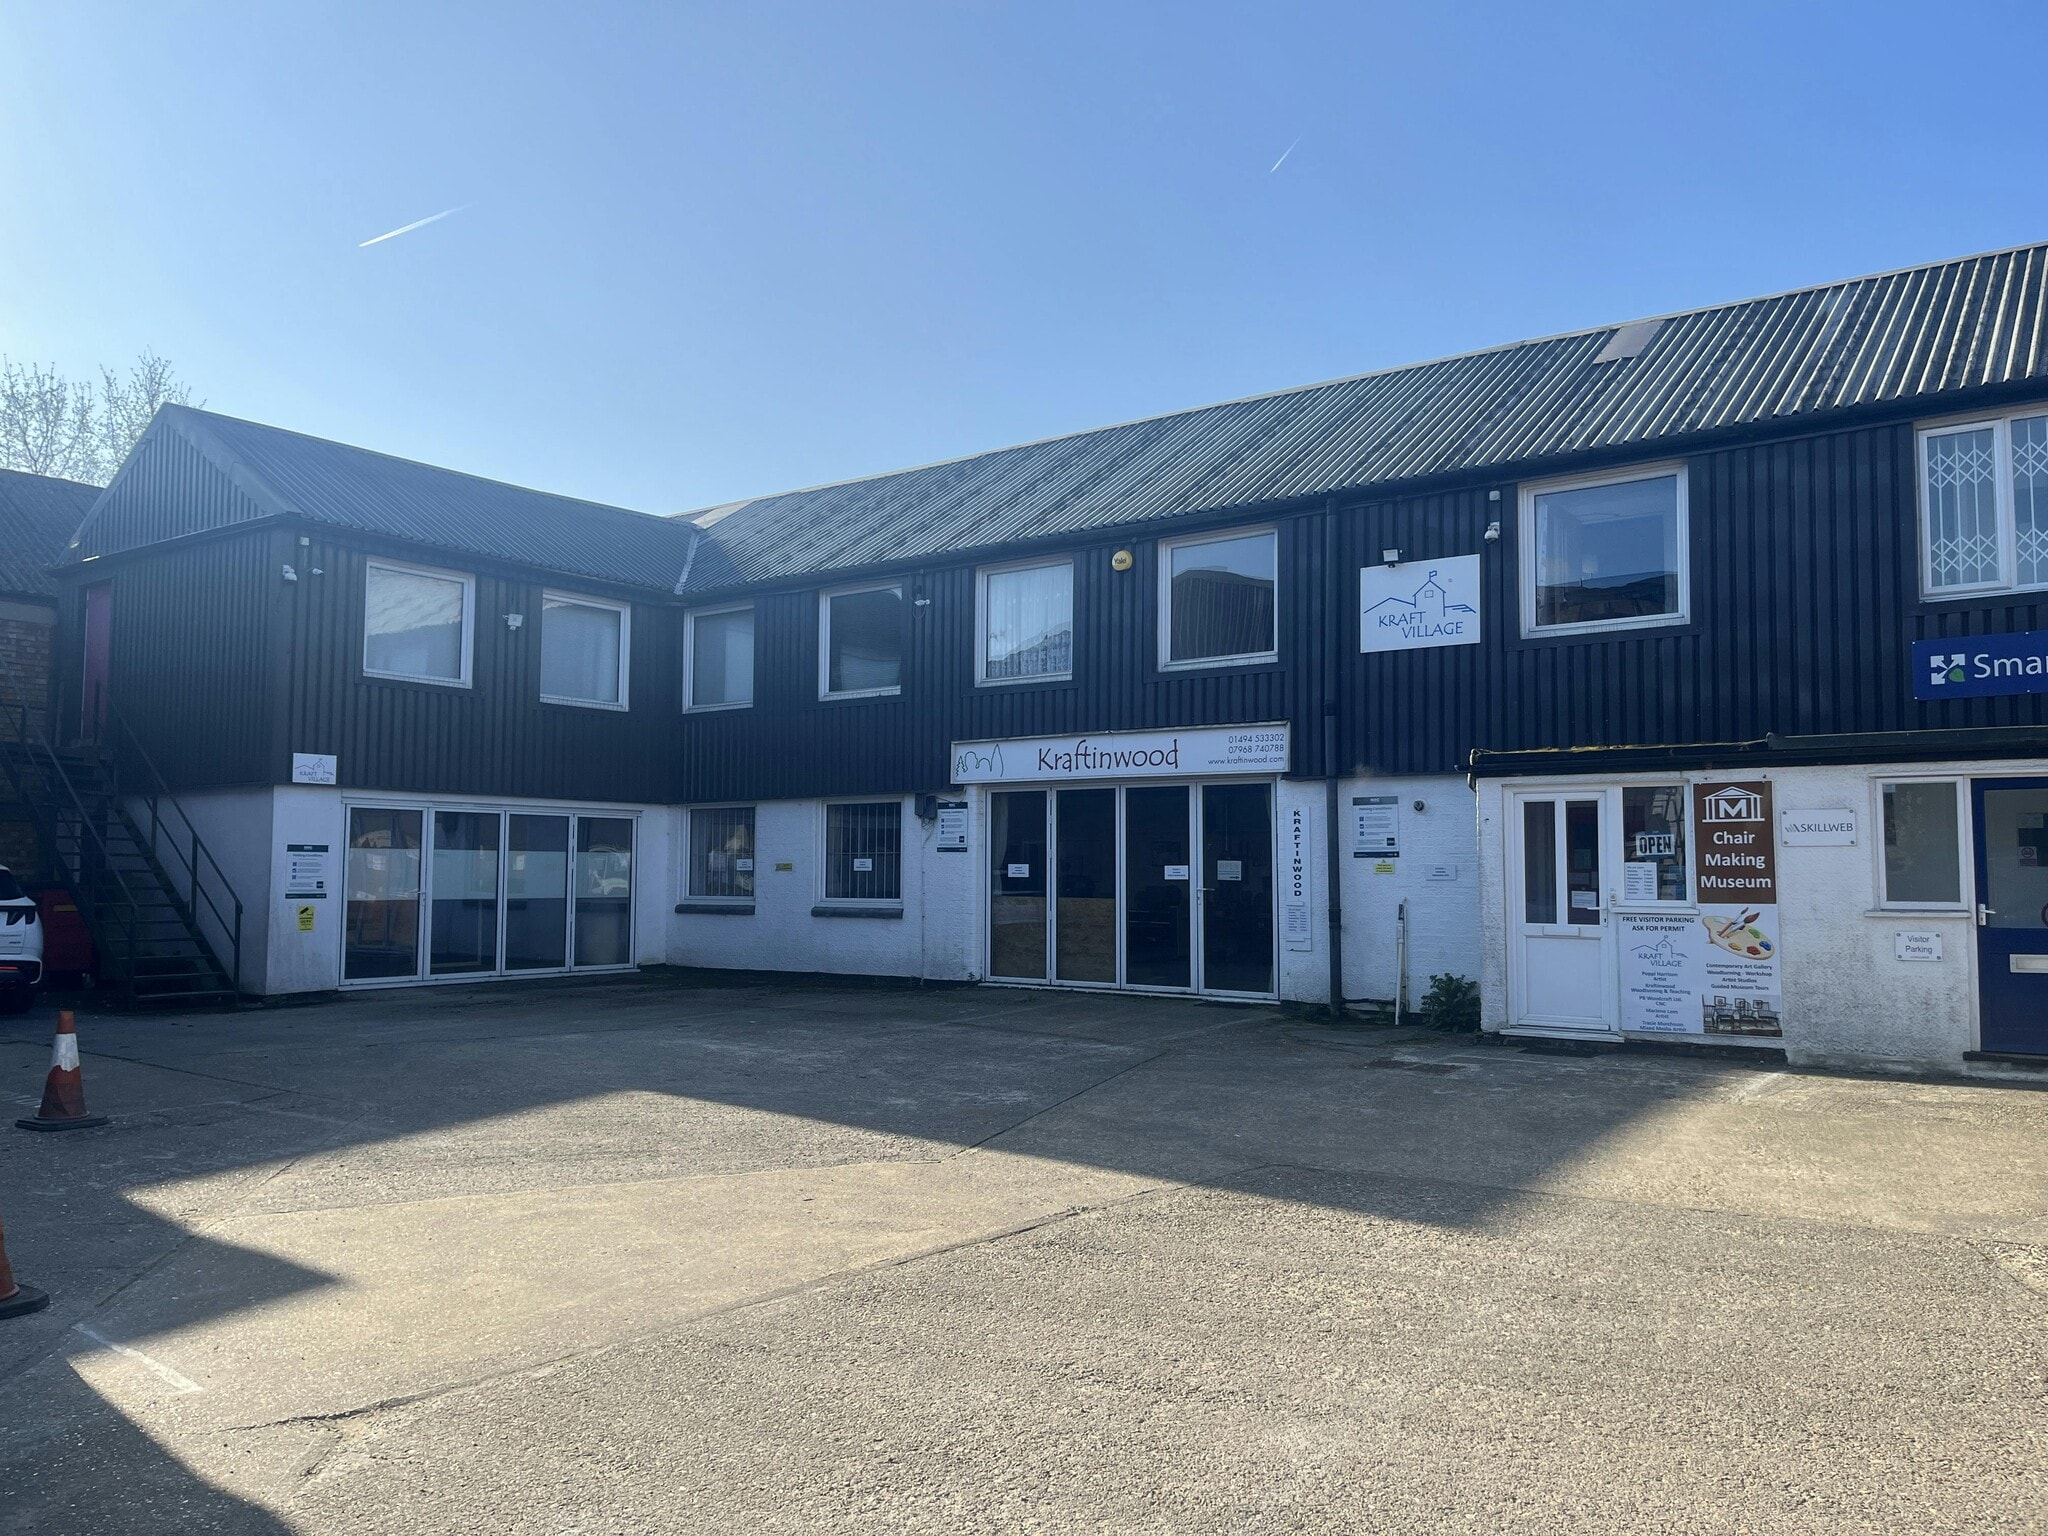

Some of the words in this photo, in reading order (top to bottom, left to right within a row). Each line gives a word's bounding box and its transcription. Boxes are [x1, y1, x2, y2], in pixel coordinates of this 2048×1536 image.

[1379, 611, 1426, 627] KRAFT
[1402, 622, 1463, 638] VILLAGE
[1228, 735, 1253, 744] 01494
[1254, 733, 1285, 742] 533302
[1037, 738, 1179, 772] Kraftinwood
[1228, 745, 1253, 754] 07968
[1254, 744, 1285, 752] 740788
[1208, 755, 1285, 765] www.kraftinwood.com
[1800, 822, 1854, 833] SKILLWEB
[1639, 835, 1672, 854] OPEN
[1713, 831, 1755, 845] Chair
[1293, 810, 1302, 897] KRAFTINWOOD
[1705, 852, 1766, 869] Making
[1700, 875, 1772, 888] Museum
[1907, 935, 1930, 943] Visitor
[1638, 952, 1663, 960] KRAFT
[1905, 945, 1933, 955] Parking
